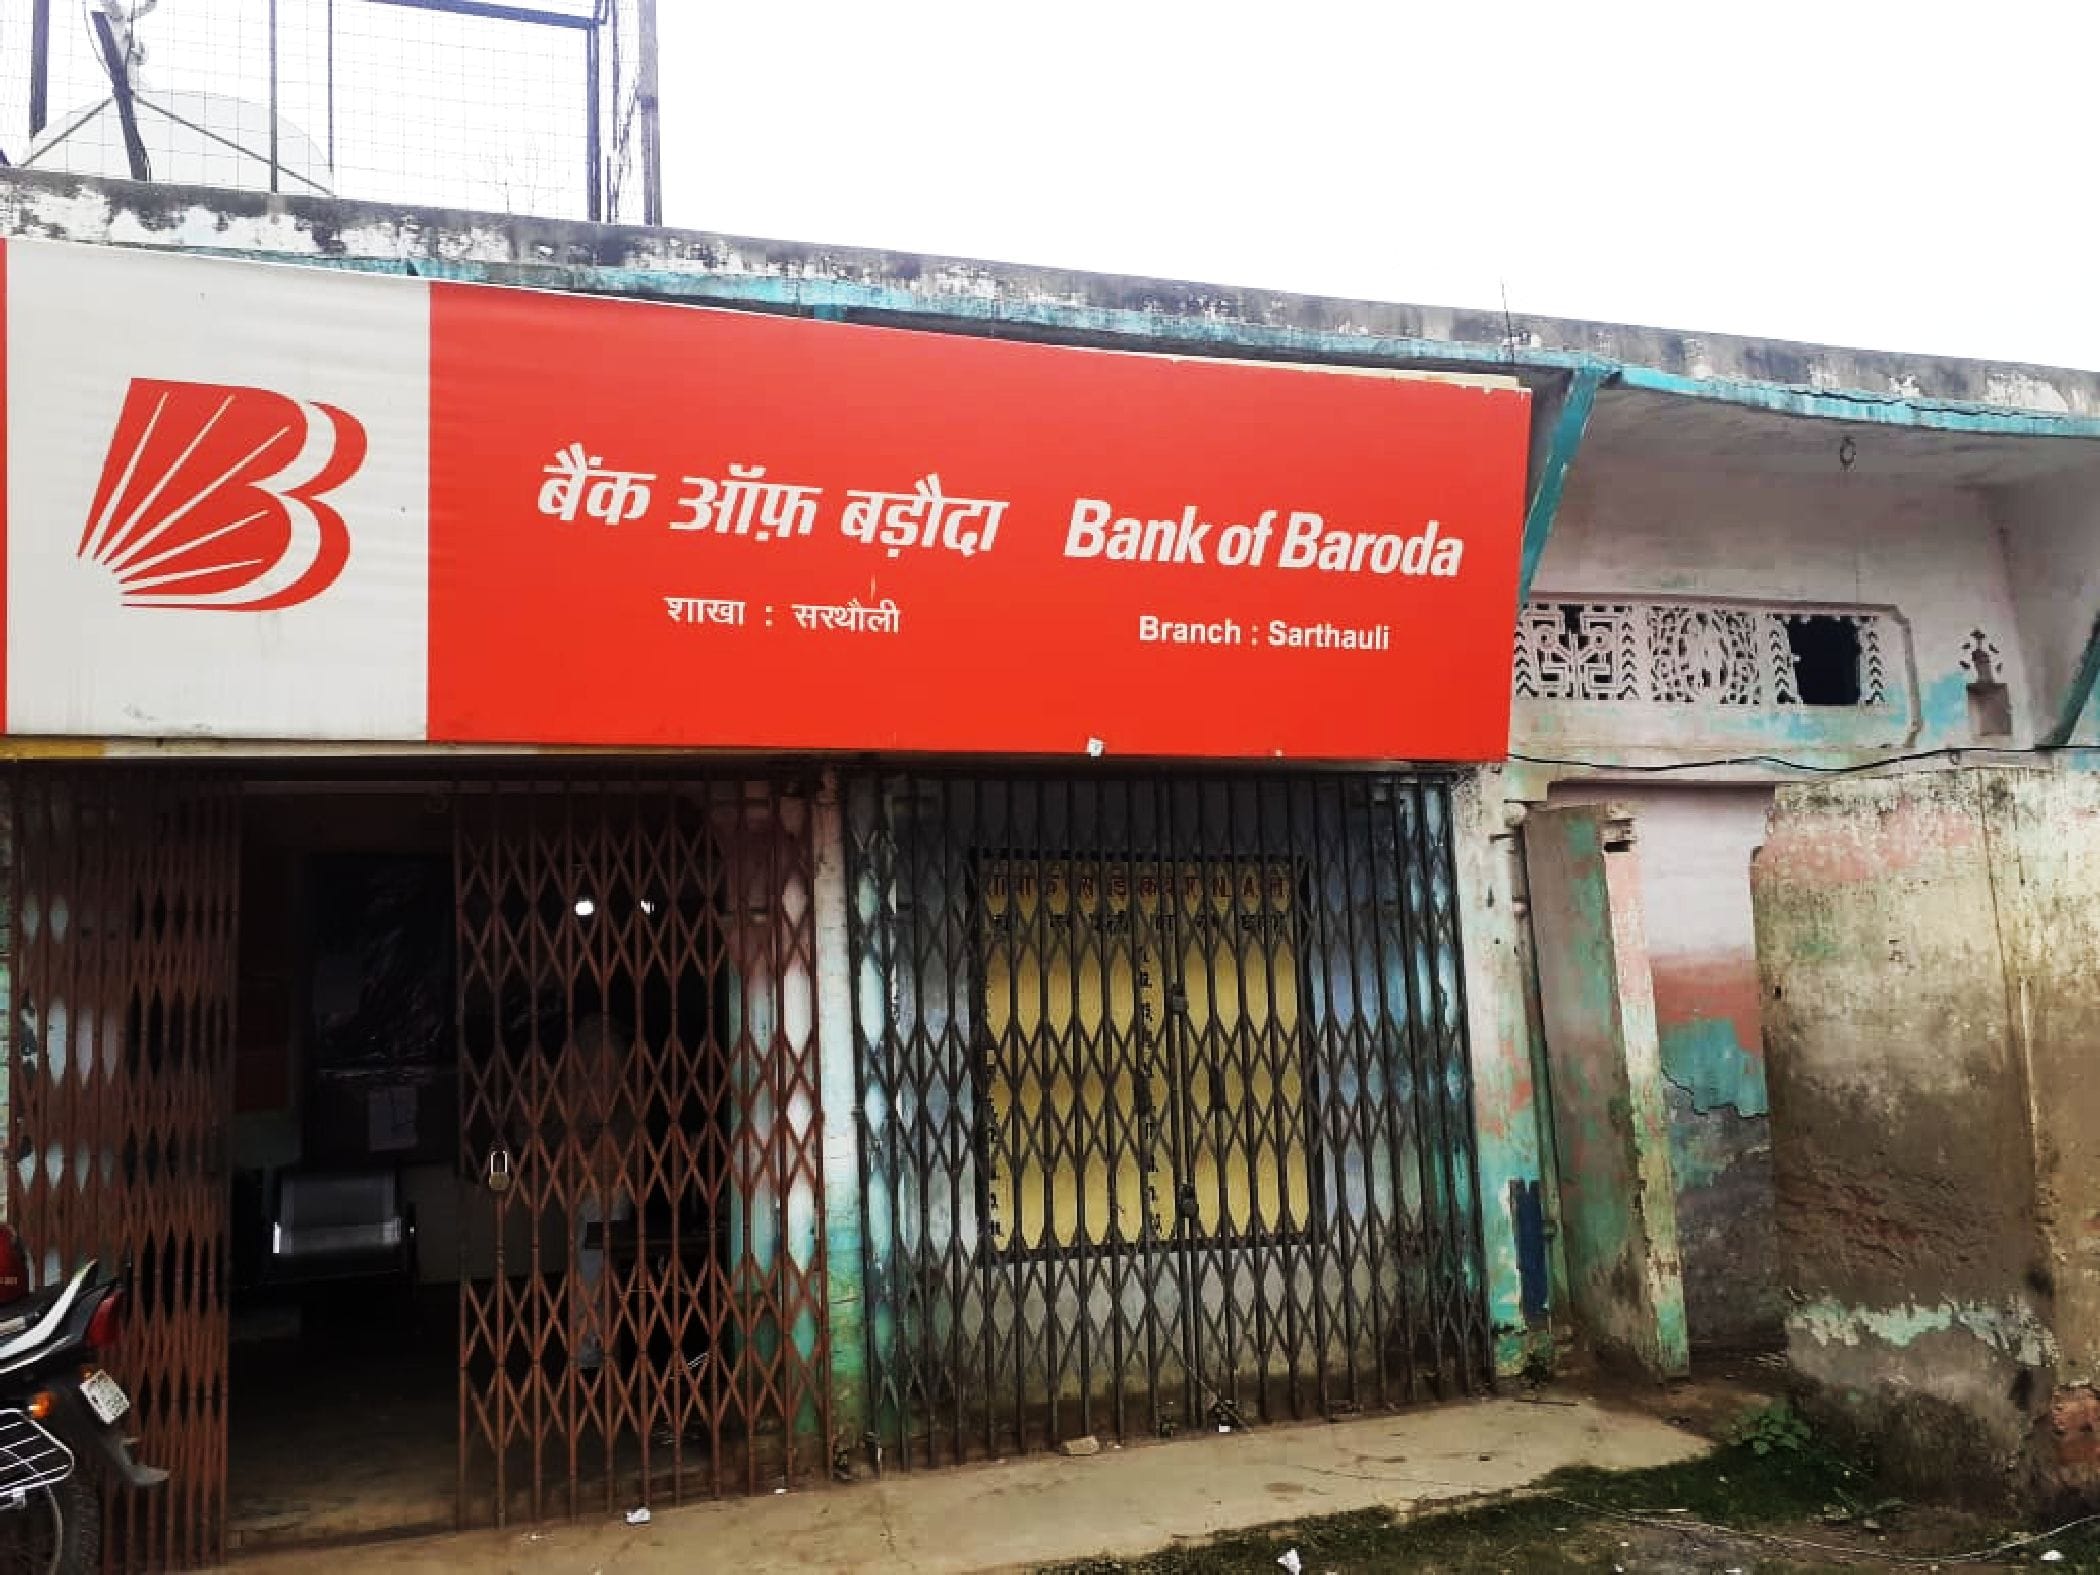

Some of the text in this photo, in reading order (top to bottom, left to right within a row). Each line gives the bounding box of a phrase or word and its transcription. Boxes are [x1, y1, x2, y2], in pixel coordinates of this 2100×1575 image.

[537, 442, 1010, 558] बैंक ऑफ़ बड़ौदा
[1064, 498, 1463, 577] Bank of Baroda
[663, 597, 746, 625] शाखा
[791, 597, 901, 633] सरथौली
[1139, 615, 1241, 644] Branch
[1268, 619, 1389, 650] Sarthauli
